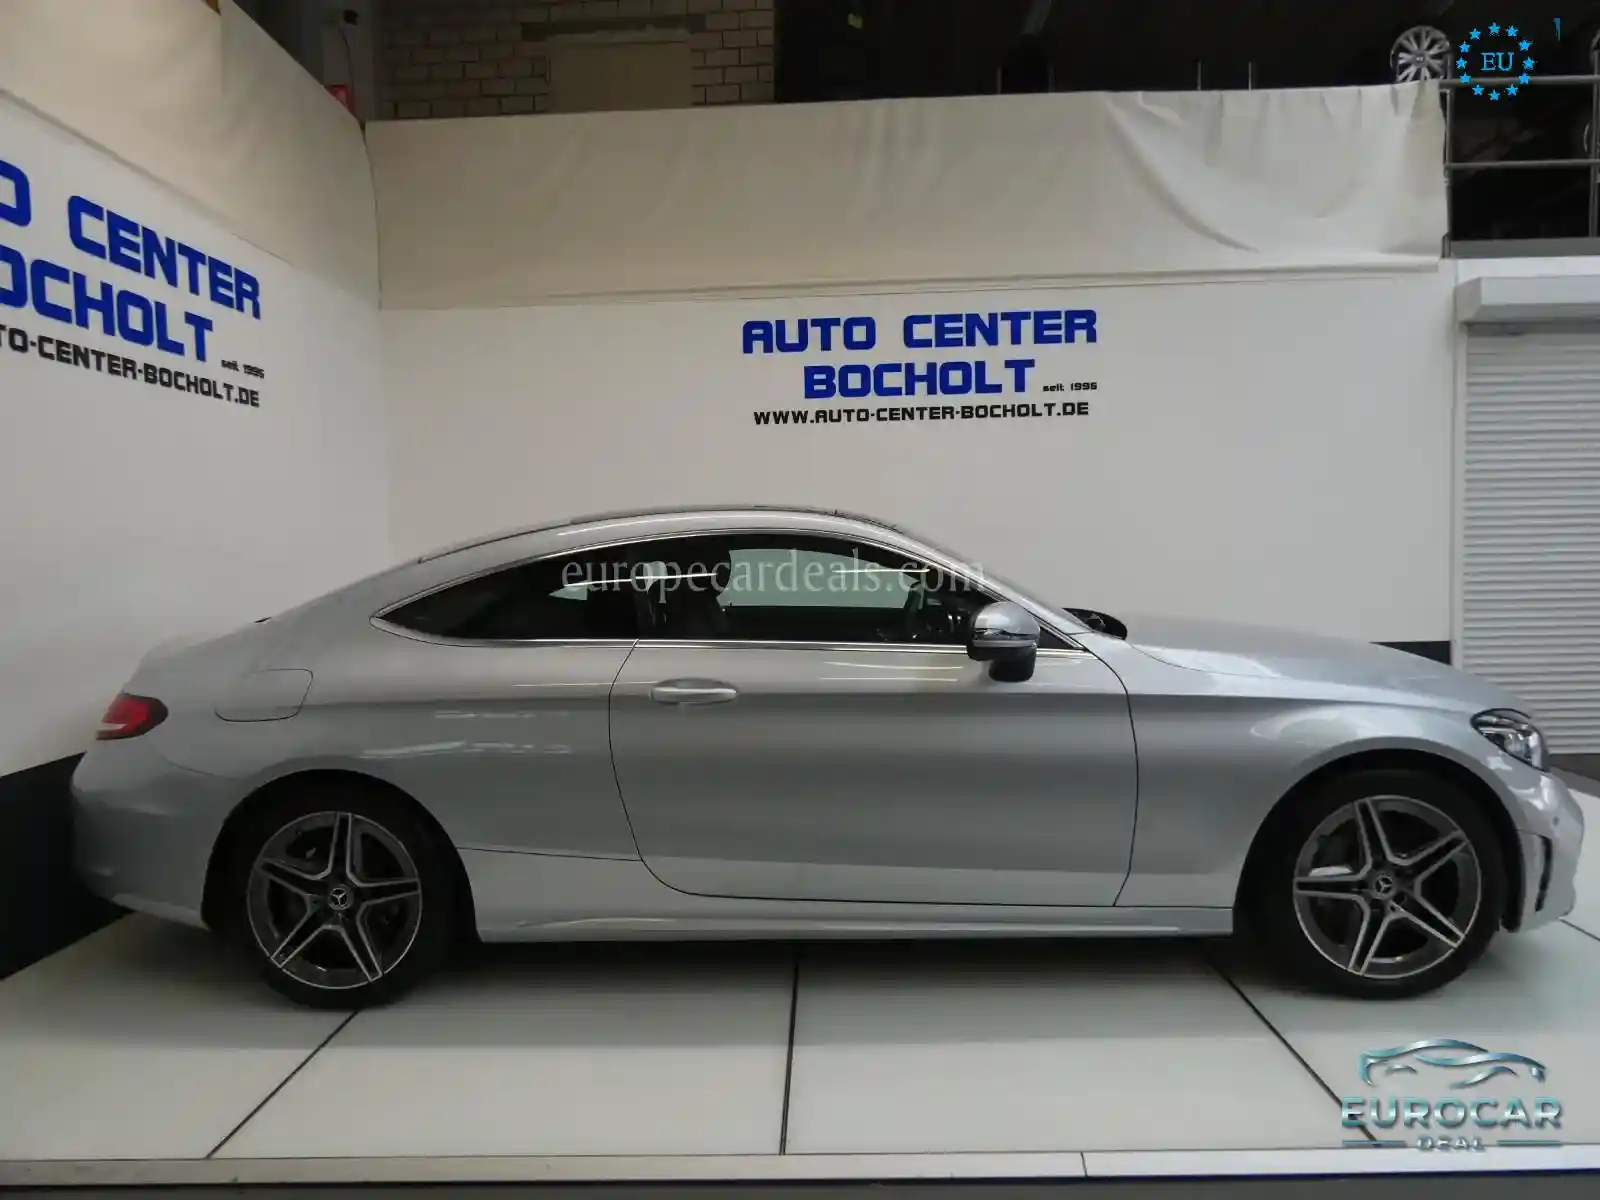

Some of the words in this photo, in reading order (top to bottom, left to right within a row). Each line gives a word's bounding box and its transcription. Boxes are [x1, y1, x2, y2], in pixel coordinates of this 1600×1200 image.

[68, 195, 260, 320] CENTER
[742, 316, 876, 354] AUTO
[903, 309, 1097, 348] CENTER
[804, 359, 1035, 399] BOCHOLT
[1042, 383, 1064, 392] seit
[753, 402, 1089, 425] WWW.AUTO-CENTER-BOCHOLT.DE
